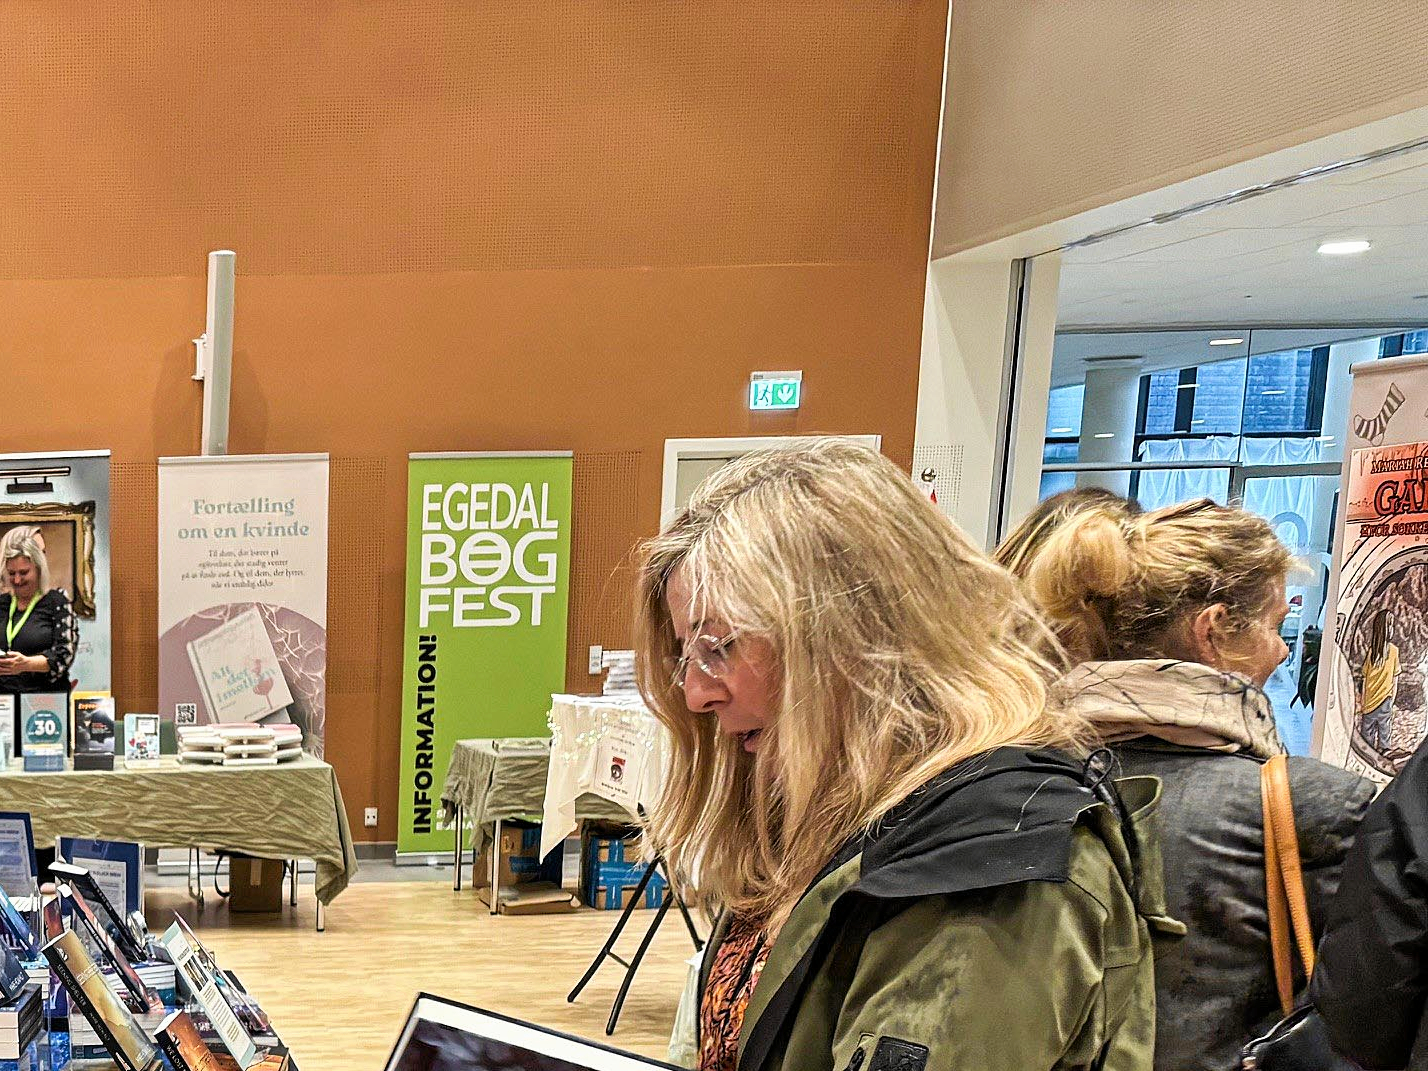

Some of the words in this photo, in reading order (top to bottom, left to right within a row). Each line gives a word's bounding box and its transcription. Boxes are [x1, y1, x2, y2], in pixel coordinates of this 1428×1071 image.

[193, 498, 295, 516] Fortælling
[422, 482, 559, 531] EGEDAL
[178, 528, 208, 539] om
[214, 527, 237, 538] en
[243, 521, 309, 538] kvinde
[419, 586, 556, 628] FEST
[413, 633, 438, 834] INFORMATION!
